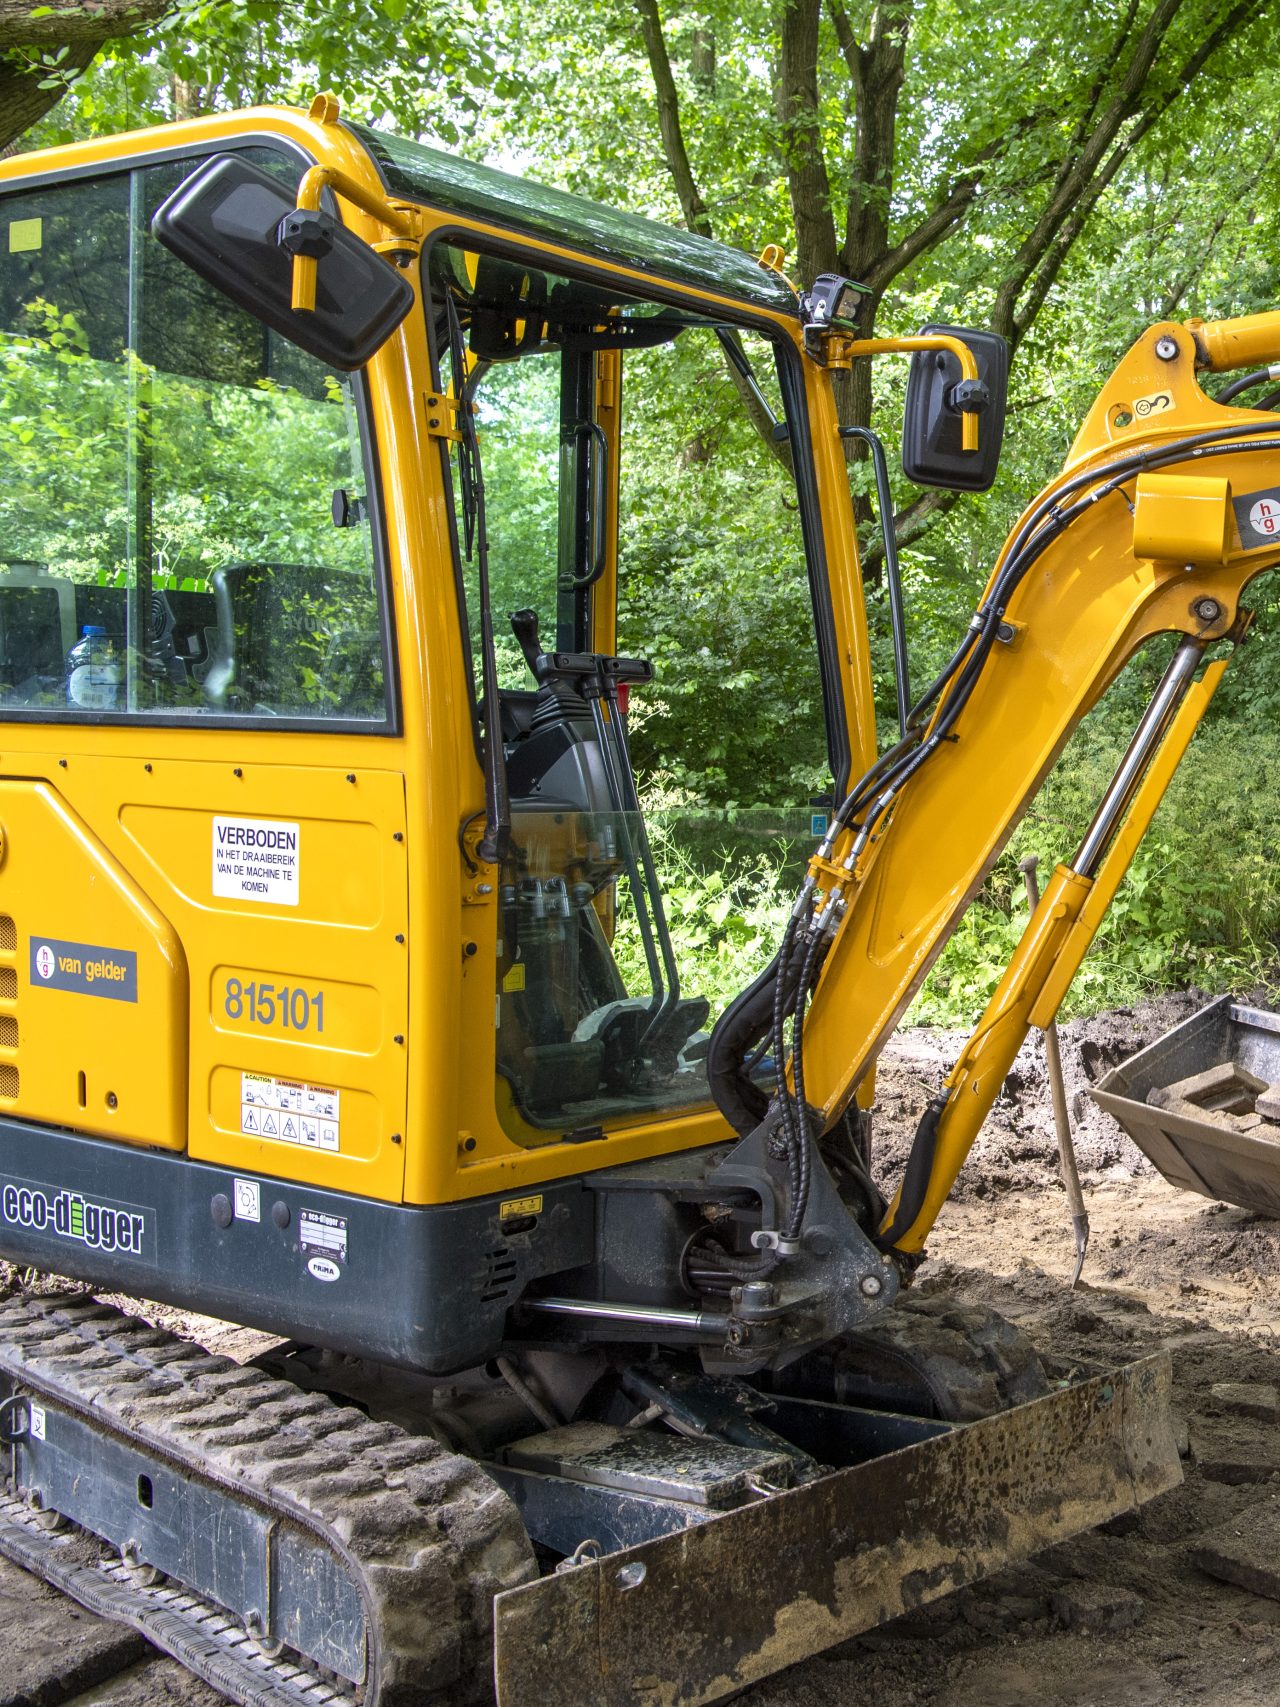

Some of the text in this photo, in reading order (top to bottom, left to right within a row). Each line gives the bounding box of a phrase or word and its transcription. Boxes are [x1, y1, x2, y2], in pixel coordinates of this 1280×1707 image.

[1259, 503, 1271, 517] h
[1264, 517, 1275, 533] g
[217, 825, 296, 851] VERBODEN
[216, 848, 296, 866] IN HET DRAAIBEREIK
[217, 863, 292, 881] VAN DE MACHINE TE
[241, 880, 269, 893] KOMEN
[42, 948, 48, 961] h
[42, 964, 48, 977] g
[58, 956, 126, 982] van gelder
[225, 977, 324, 1032] 815101
[248, 1074, 271, 1083] CAUTION
[281, 1081, 302, 1090] WARNING
[313, 1087, 335, 1095] WARNING
